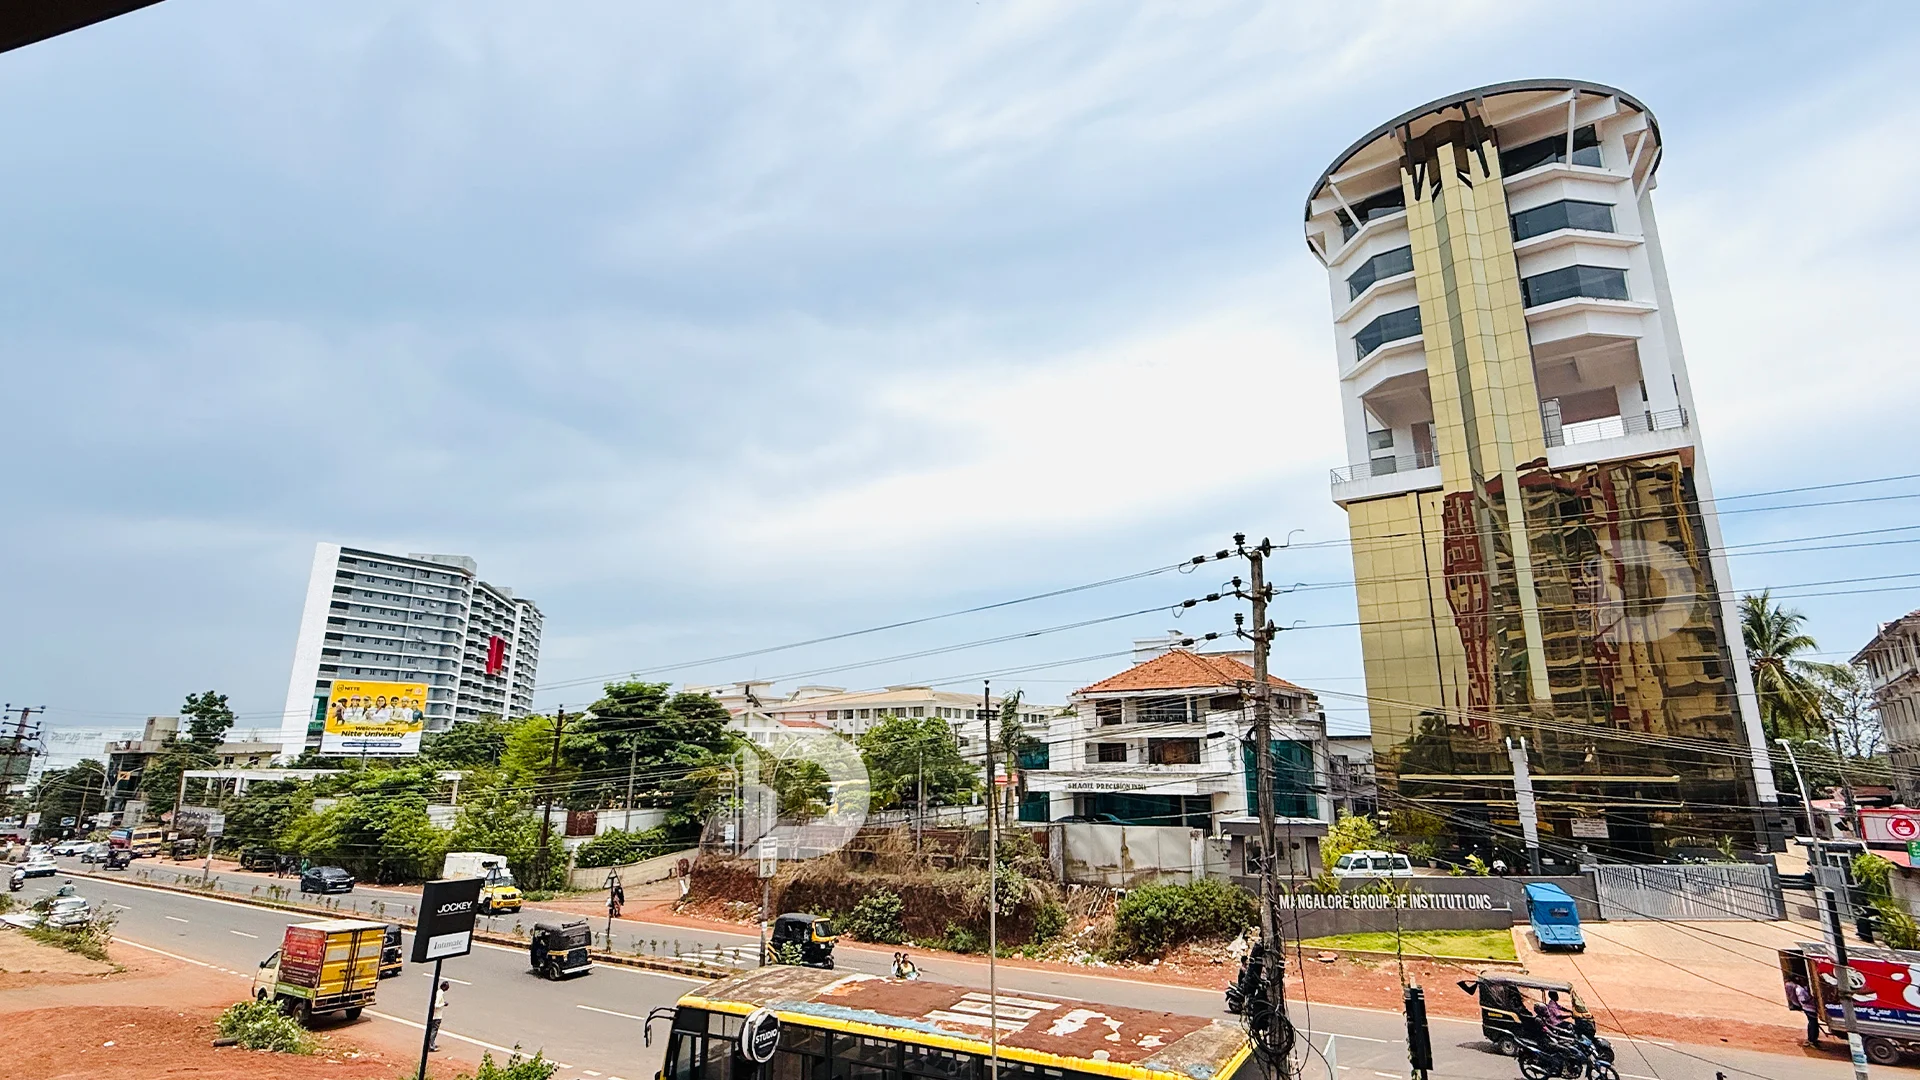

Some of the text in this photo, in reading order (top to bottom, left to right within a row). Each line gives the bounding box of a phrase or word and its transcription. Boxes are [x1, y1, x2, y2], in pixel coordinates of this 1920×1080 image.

[364, 731, 406, 739] University
[436, 901, 473, 914] JOCKEY
[1278, 893, 1350, 910] MANGALORE
[1352, 893, 1390, 910] GROUP
[1409, 893, 1492, 910] INSTITUTIONS
[433, 939, 464, 950] Intimate
[755, 1028, 777, 1044] STUDIO
